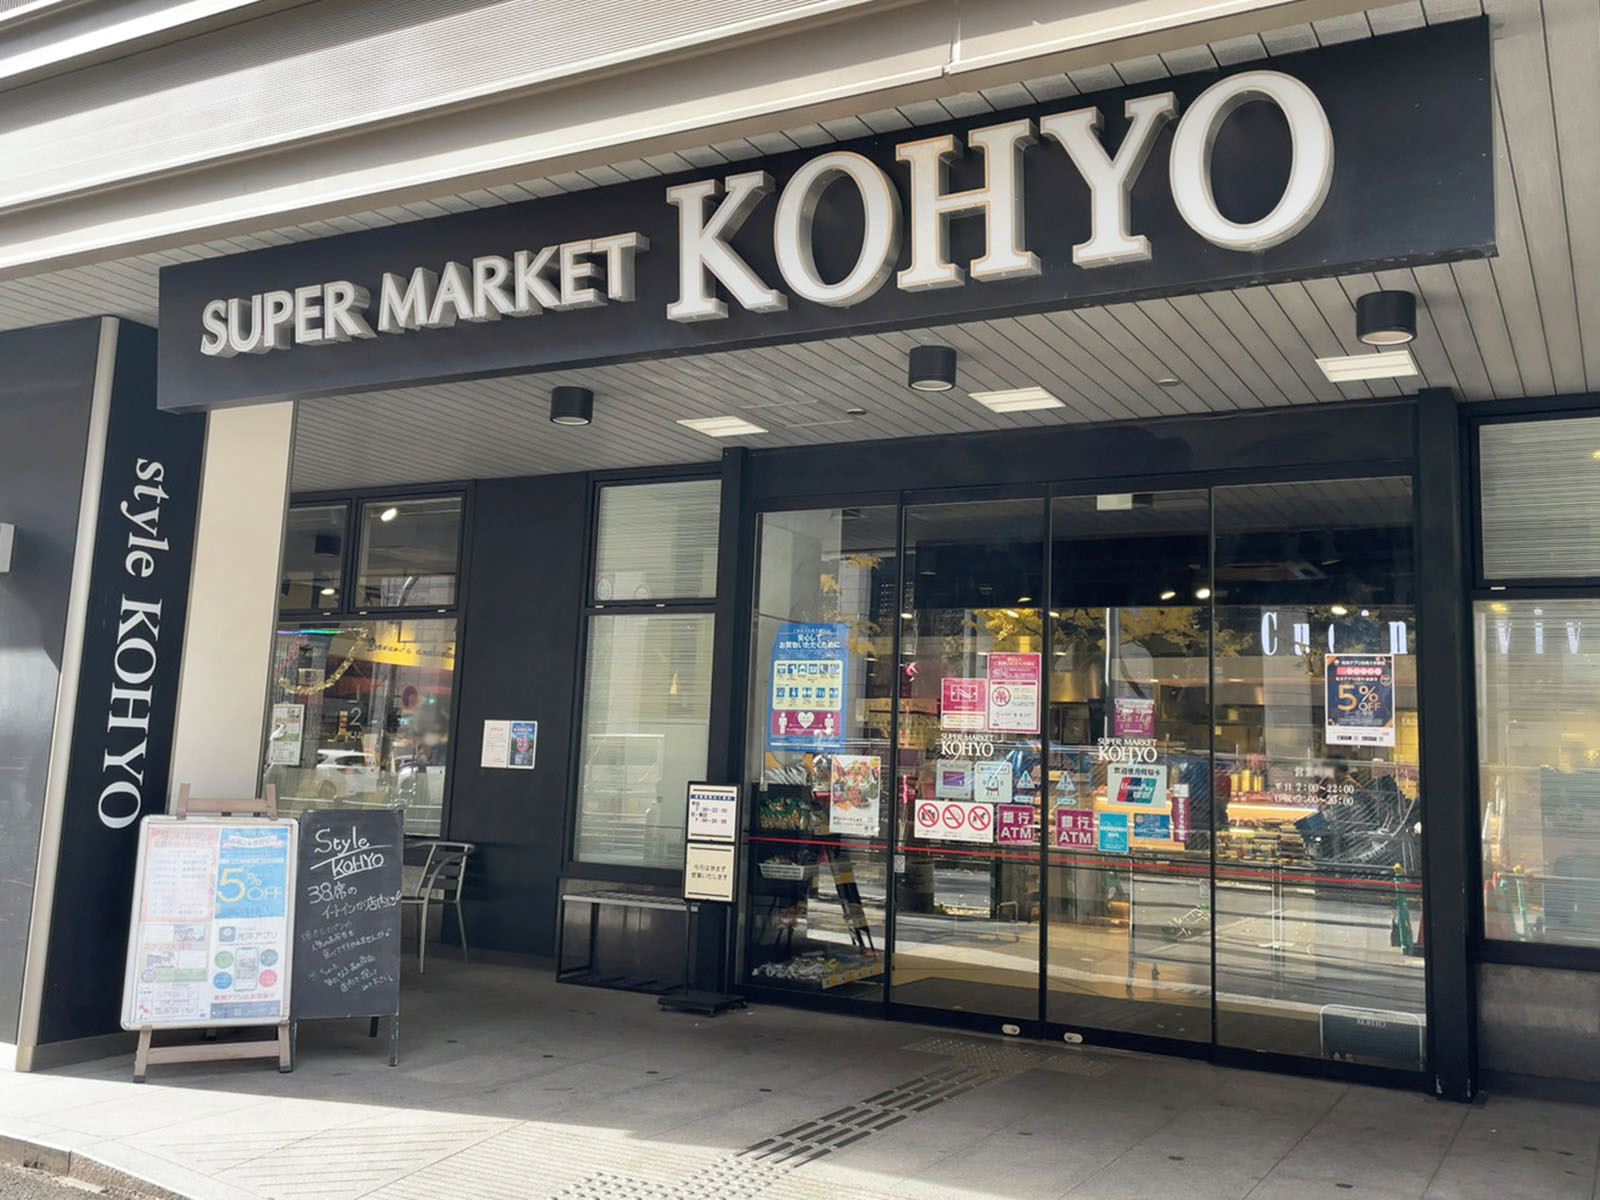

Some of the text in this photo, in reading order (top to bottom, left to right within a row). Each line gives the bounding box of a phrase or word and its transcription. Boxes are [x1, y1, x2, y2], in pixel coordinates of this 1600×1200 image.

[201, 70, 1334, 357] SUPER MARKET KOHYO
[98, 458, 169, 829] style KOHYO
[1359, 702, 1381, 712] OFF
[941, 741, 995, 757] KOHYO
[1097, 737, 1158, 747] SUPER MARKET
[1098, 746, 1158, 763] KOHYO
[1002, 811, 1030, 824] 銀行
[1061, 816, 1090, 829] 銀行
[1001, 827, 1032, 839] ATM
[1059, 833, 1091, 844] ATM
[314, 826, 370, 857] Style
[331, 852, 384, 877] KOHYO
[247, 886, 283, 901] OFF
